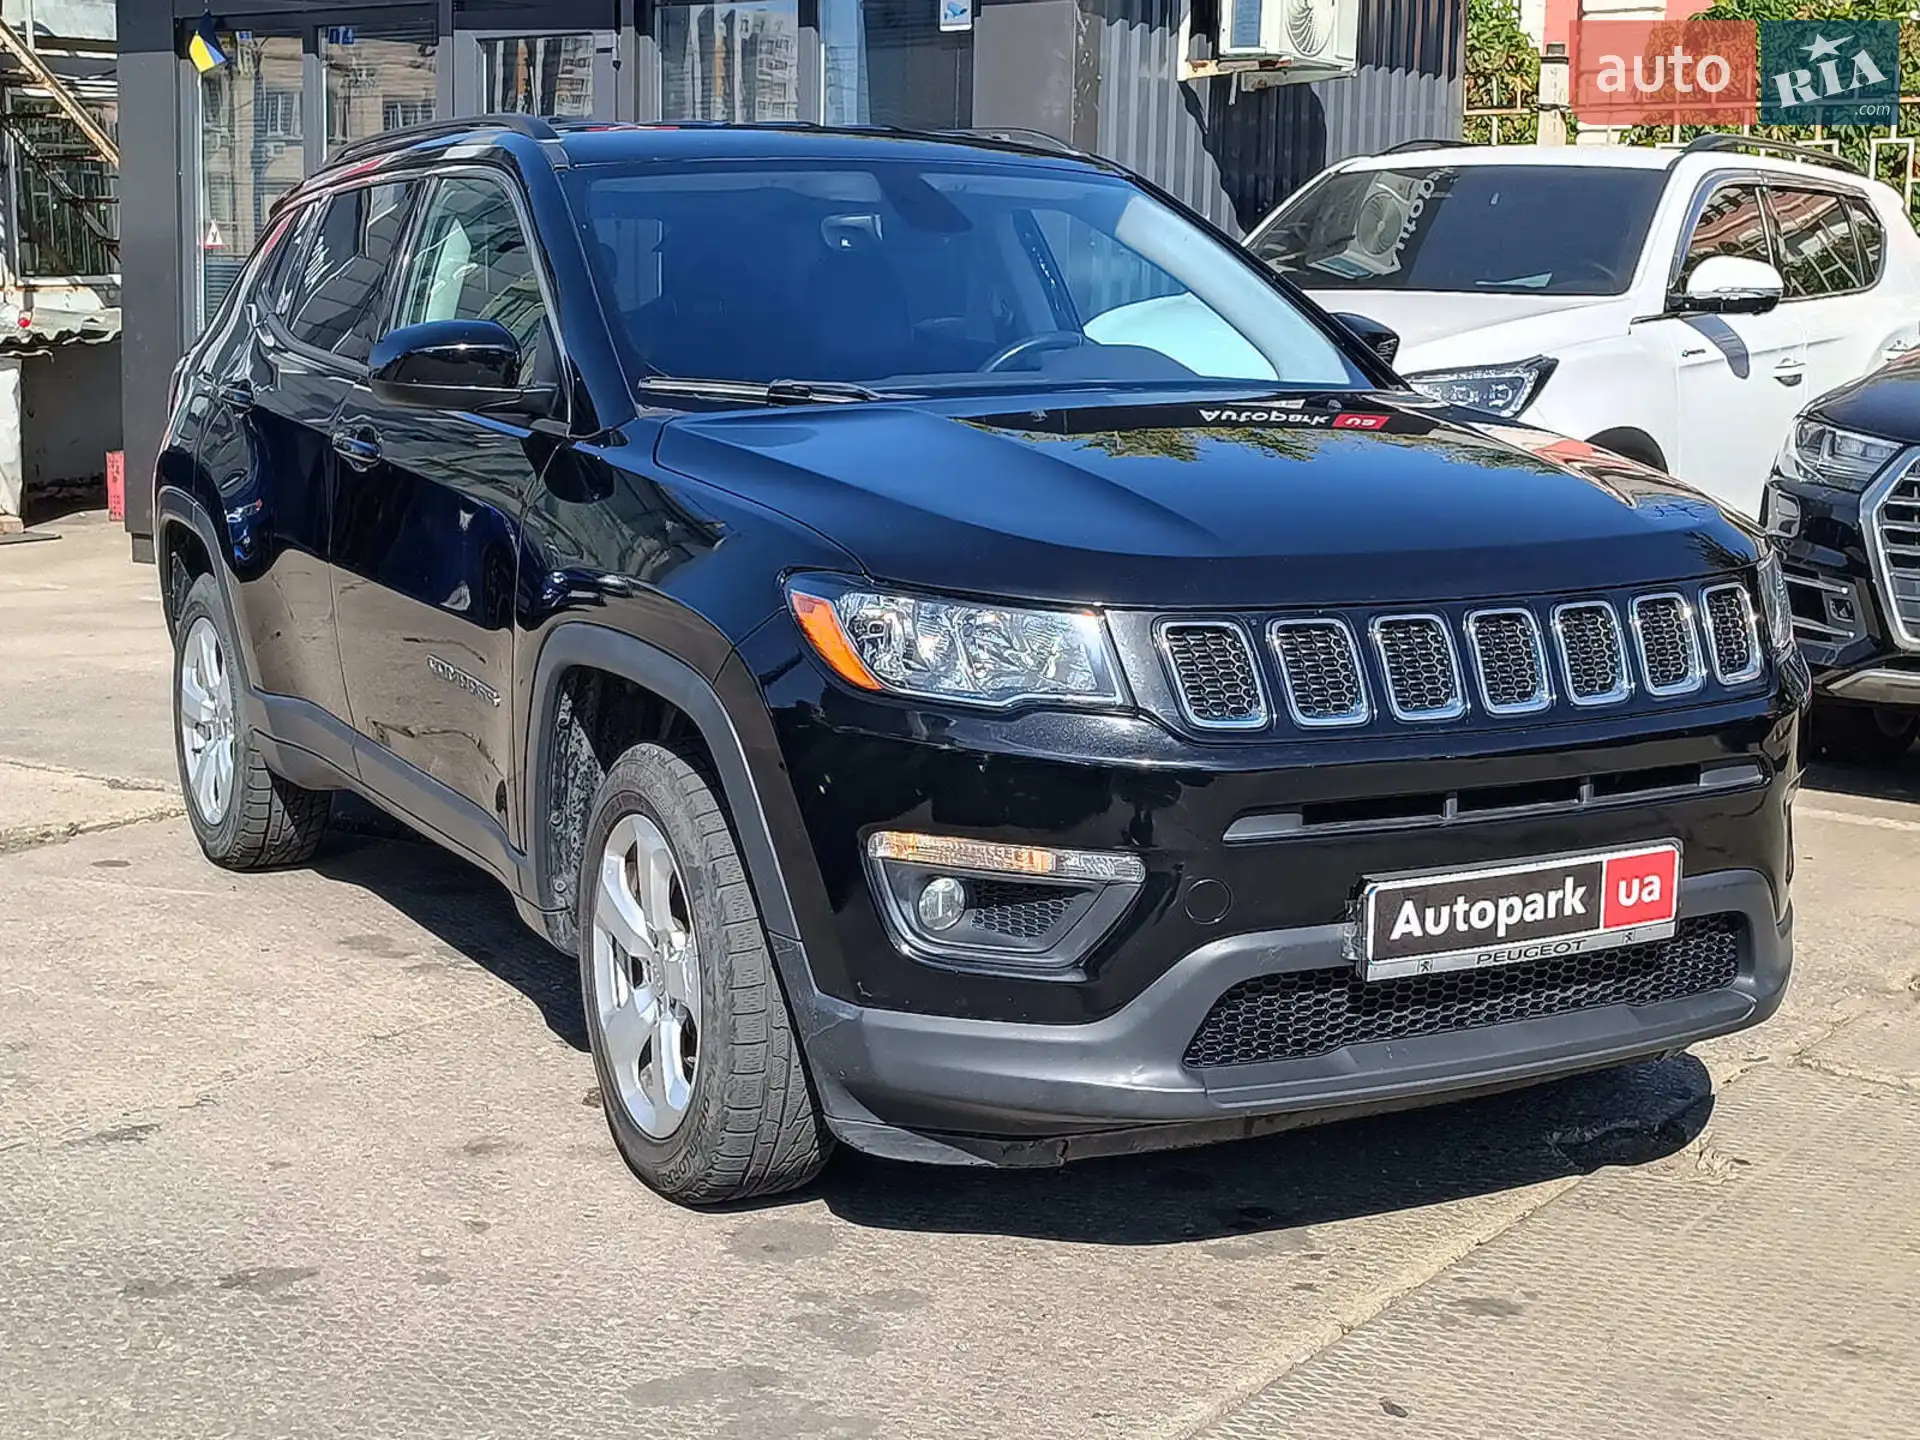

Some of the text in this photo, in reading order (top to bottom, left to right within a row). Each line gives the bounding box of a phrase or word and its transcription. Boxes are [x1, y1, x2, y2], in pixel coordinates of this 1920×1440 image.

[1390, 874, 1662, 940] Autopark ua
[1476, 939, 1587, 966] PEUGEOT
